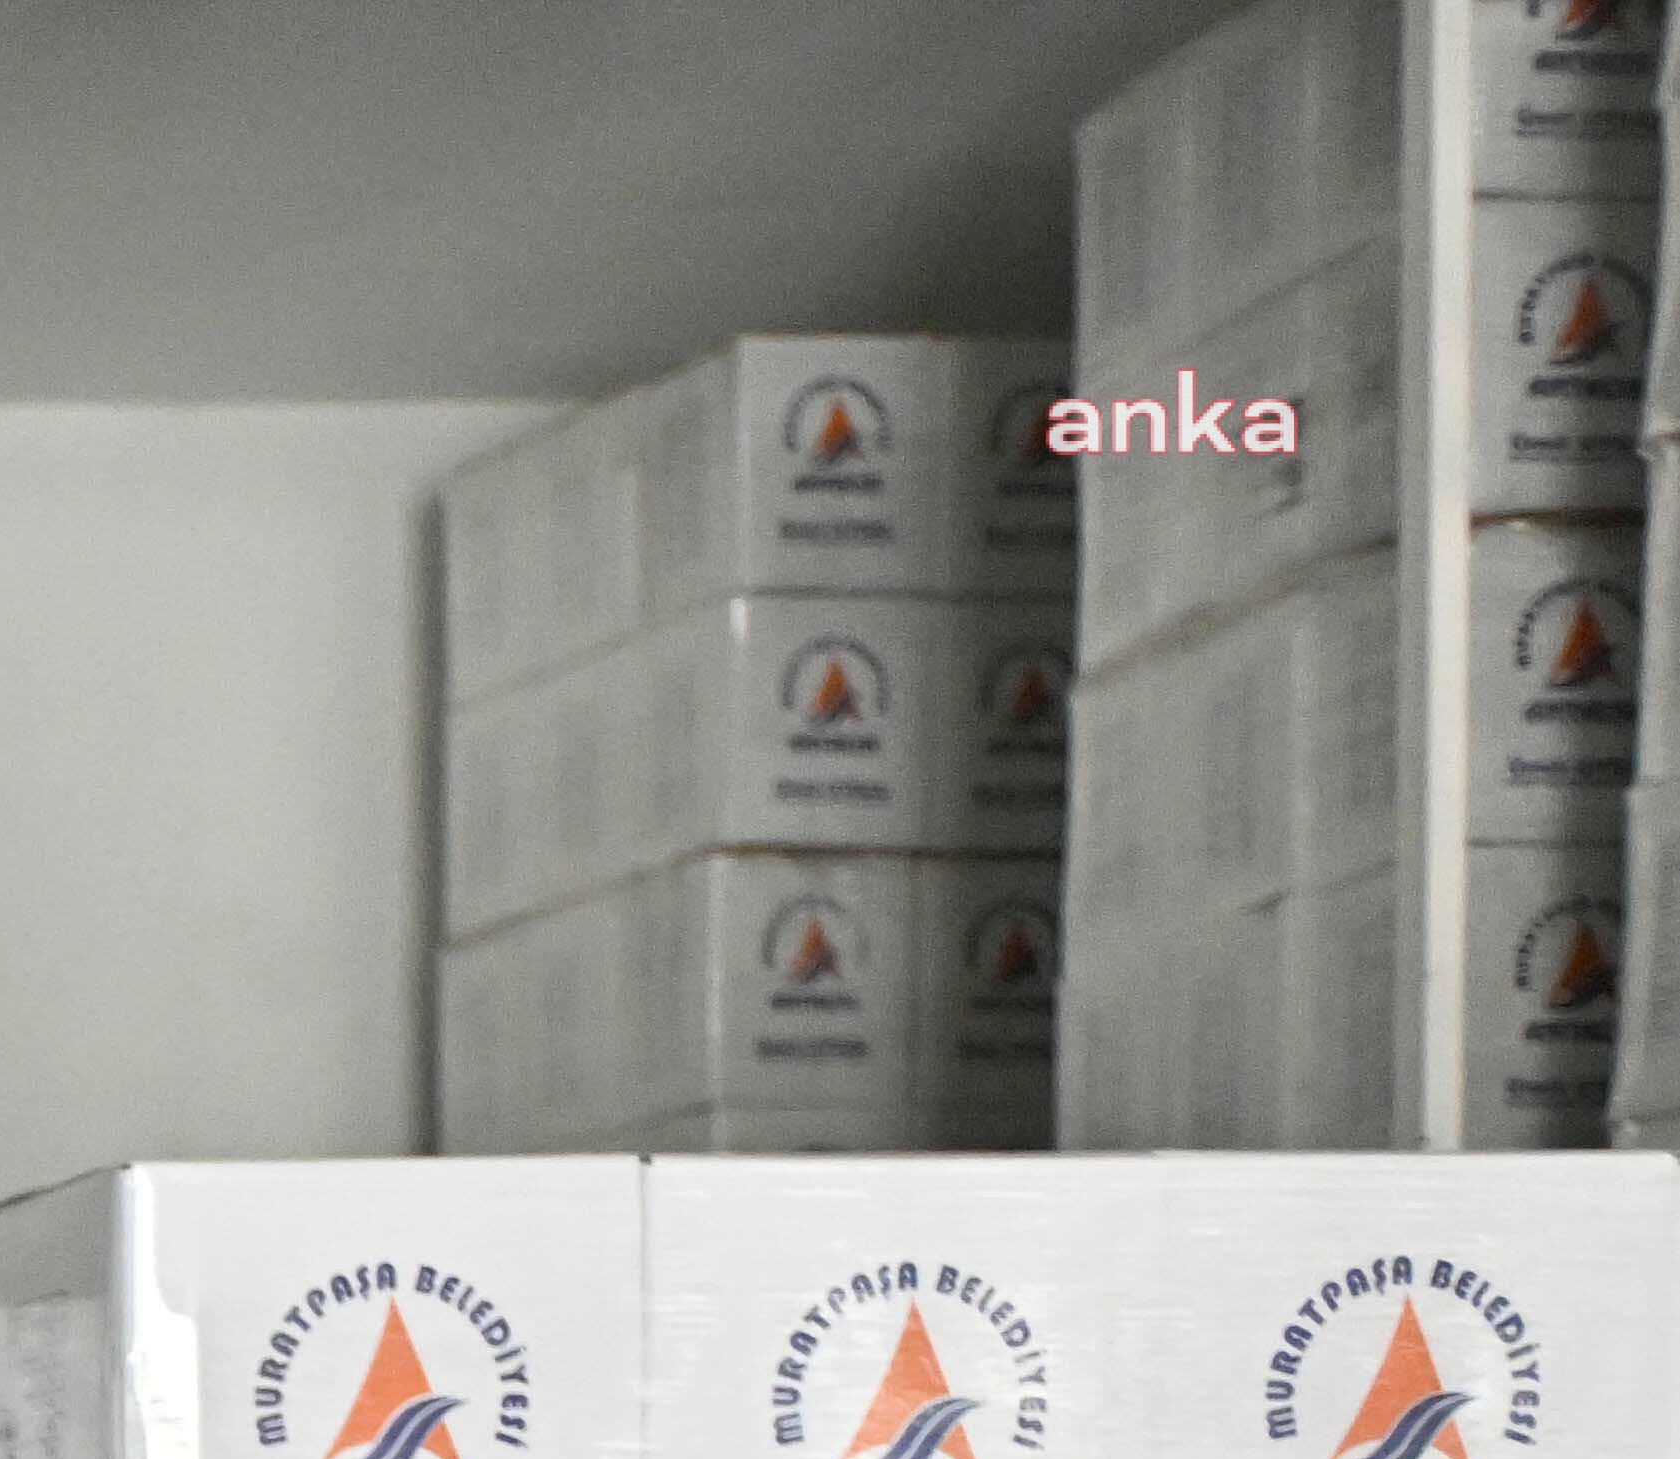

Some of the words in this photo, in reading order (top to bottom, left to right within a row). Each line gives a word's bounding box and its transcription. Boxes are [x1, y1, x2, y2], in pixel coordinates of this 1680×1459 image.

[254, 1261, 397, 1446] MURATPAŞA
[414, 1264, 530, 1448] BELEDİYESİ
[772, 1260, 918, 1446] MURATPAŞA
[1265, 1255, 1413, 1440] MURATPAŞA
[1430, 1259, 1541, 1446] BELEDİYESİ
